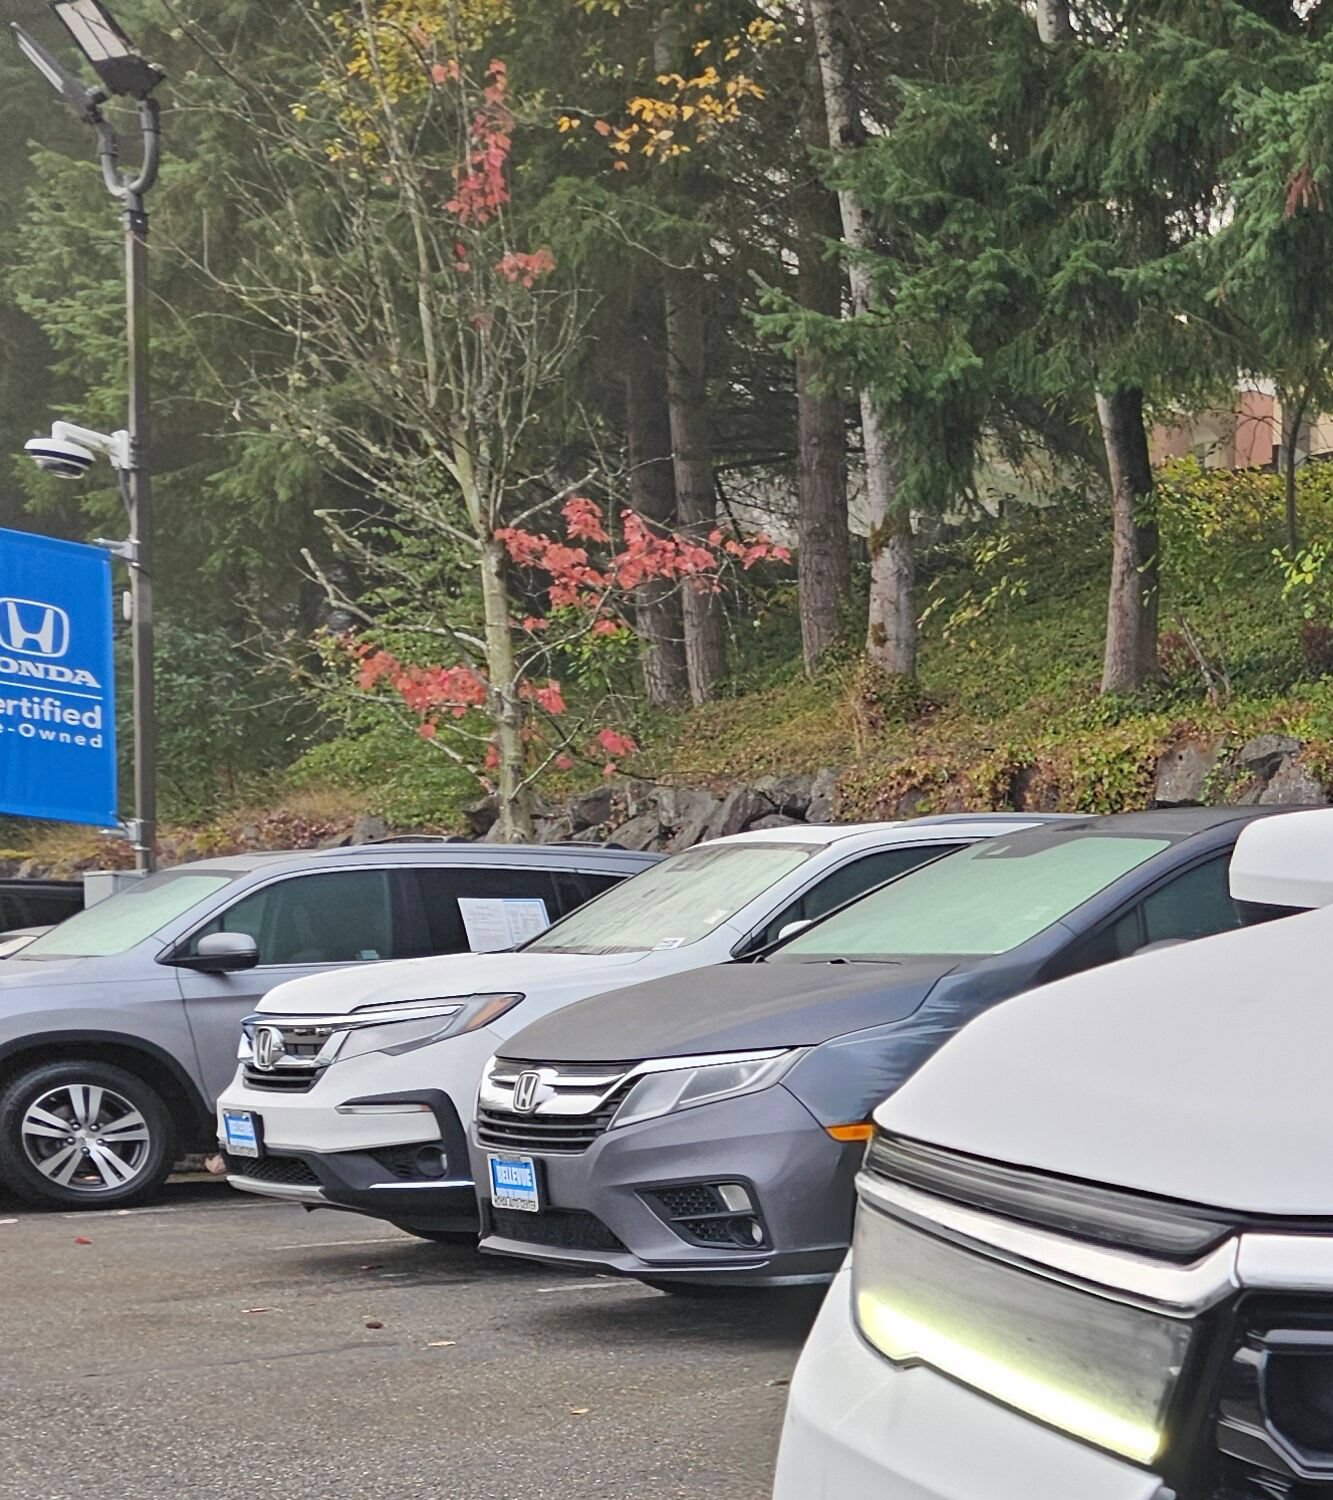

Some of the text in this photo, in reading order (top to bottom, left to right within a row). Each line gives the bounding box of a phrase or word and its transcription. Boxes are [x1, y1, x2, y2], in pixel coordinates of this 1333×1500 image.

[0, 656, 102, 688] ONDA
[0, 697, 103, 730] rtified
[0, 722, 103, 748] -Owned
